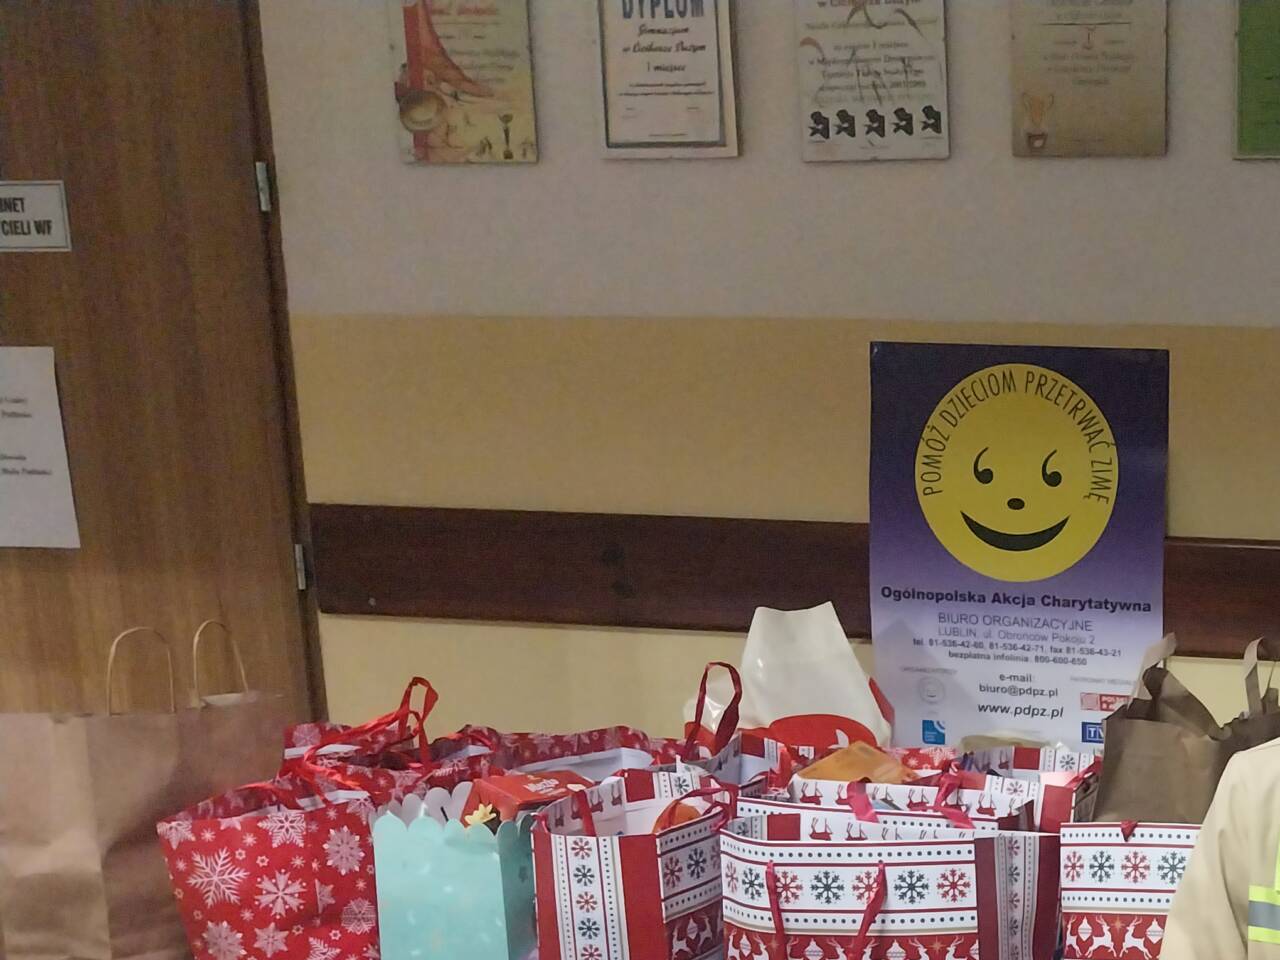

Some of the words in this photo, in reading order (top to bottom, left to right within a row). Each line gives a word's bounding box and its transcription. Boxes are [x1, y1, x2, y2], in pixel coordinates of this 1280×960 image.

[34, 220, 52, 235] WF
[921, 425, 950, 496] POMÓŻ
[940, 370, 1016, 428] DZIECIOM
[1024, 371, 1116, 453] PRZETRWAĆ
[1083, 457, 1113, 504] ZIMĘ
[881, 586, 986, 604] Ogólnopolska
[991, 592, 1036, 609] Akcja
[1041, 594, 1152, 613] Charytatywna
[937, 611, 979, 626] BIURO
[982, 615, 1094, 632] ORGANIZACYJNE
[1088, 635, 1096, 645] 2
[1049, 645, 1062, 653] fax
[979, 684, 1058, 698] biuro@pdpz.pl
[978, 704, 1064, 720] www.pdpz.pl
